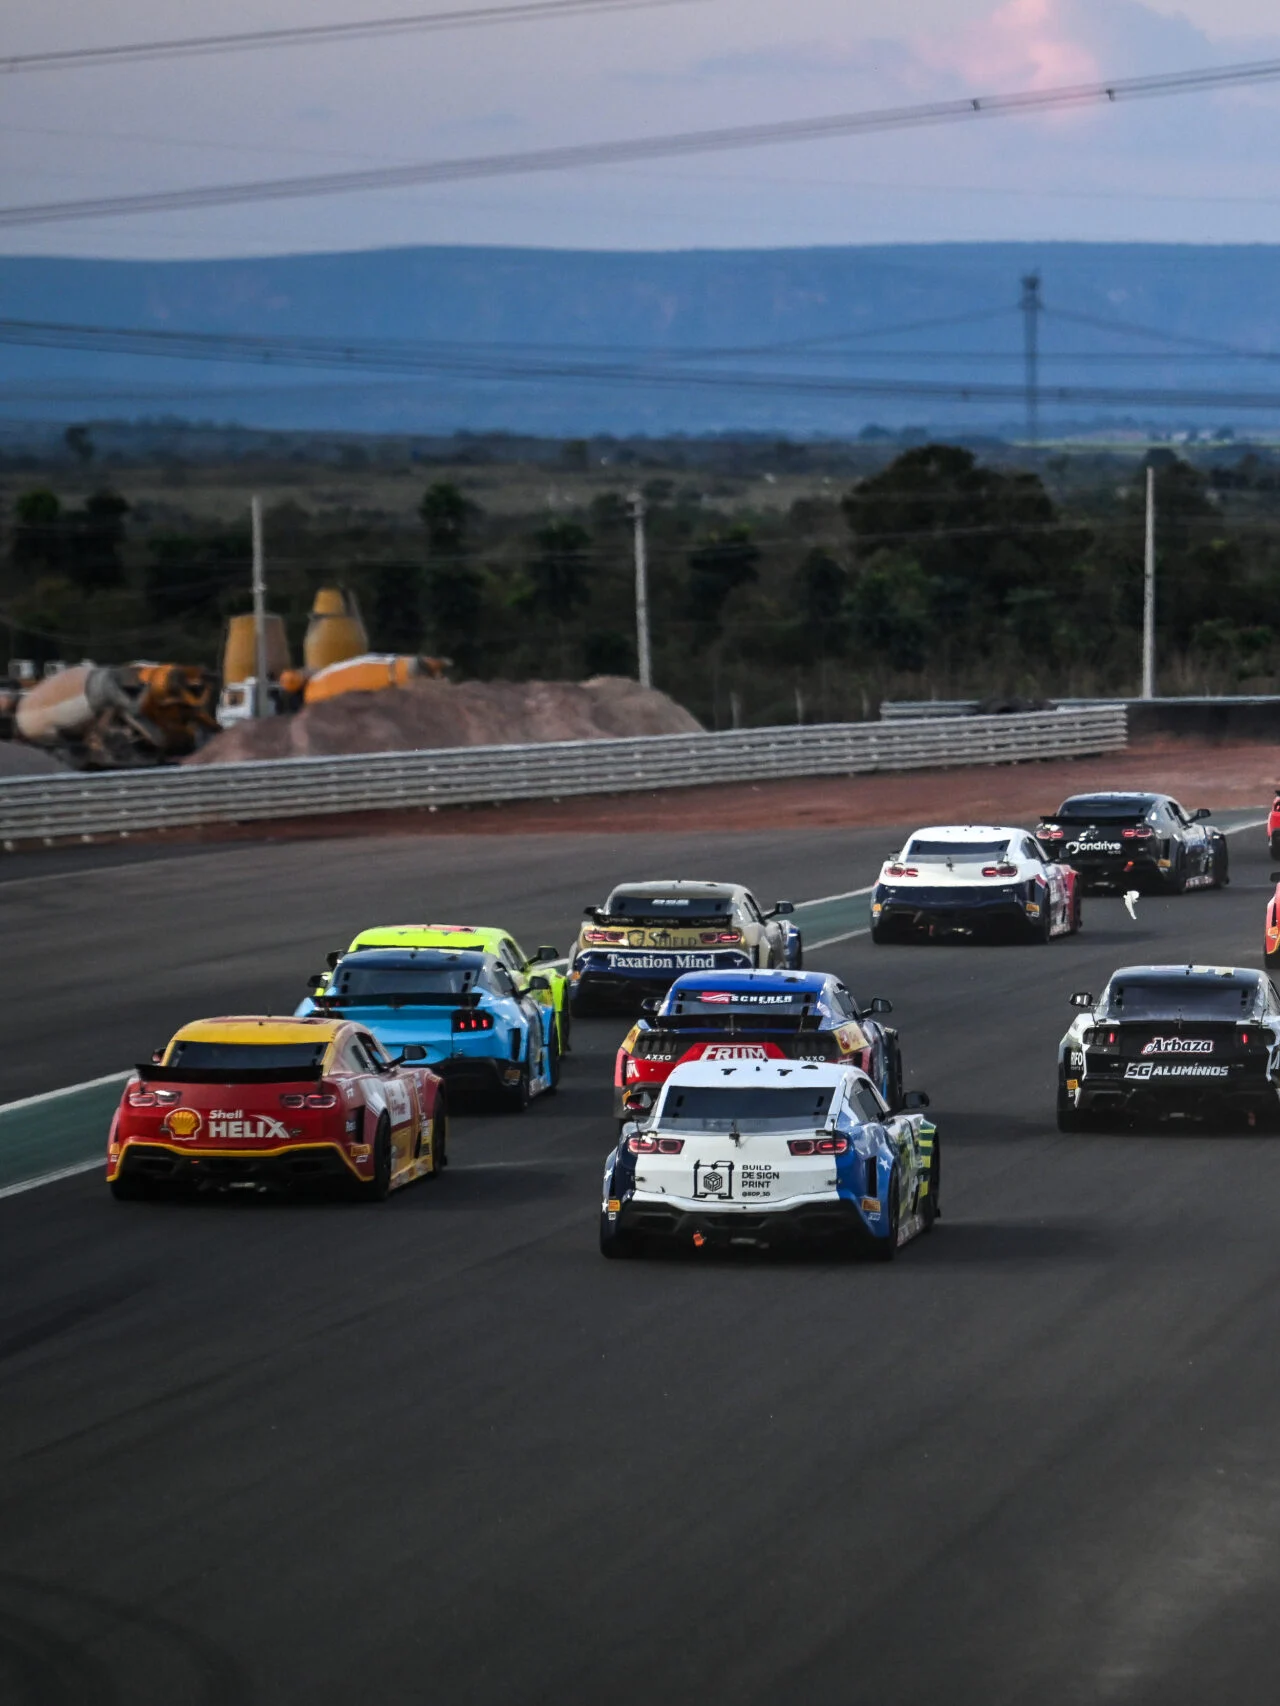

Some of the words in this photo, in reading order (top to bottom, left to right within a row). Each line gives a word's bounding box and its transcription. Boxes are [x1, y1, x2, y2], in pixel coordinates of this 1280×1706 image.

[607, 953, 673, 969] Taxation
[675, 953, 715, 969] Mind
[1142, 1037, 1214, 1055] Arbaza
[1152, 1062, 1229, 1076] ALUMÍNIOS
[209, 1109, 243, 1119] Shell
[208, 1115, 290, 1139] HELIX
[742, 1172, 780, 1180] DESIGN
[742, 1181, 771, 1189] PRINT
